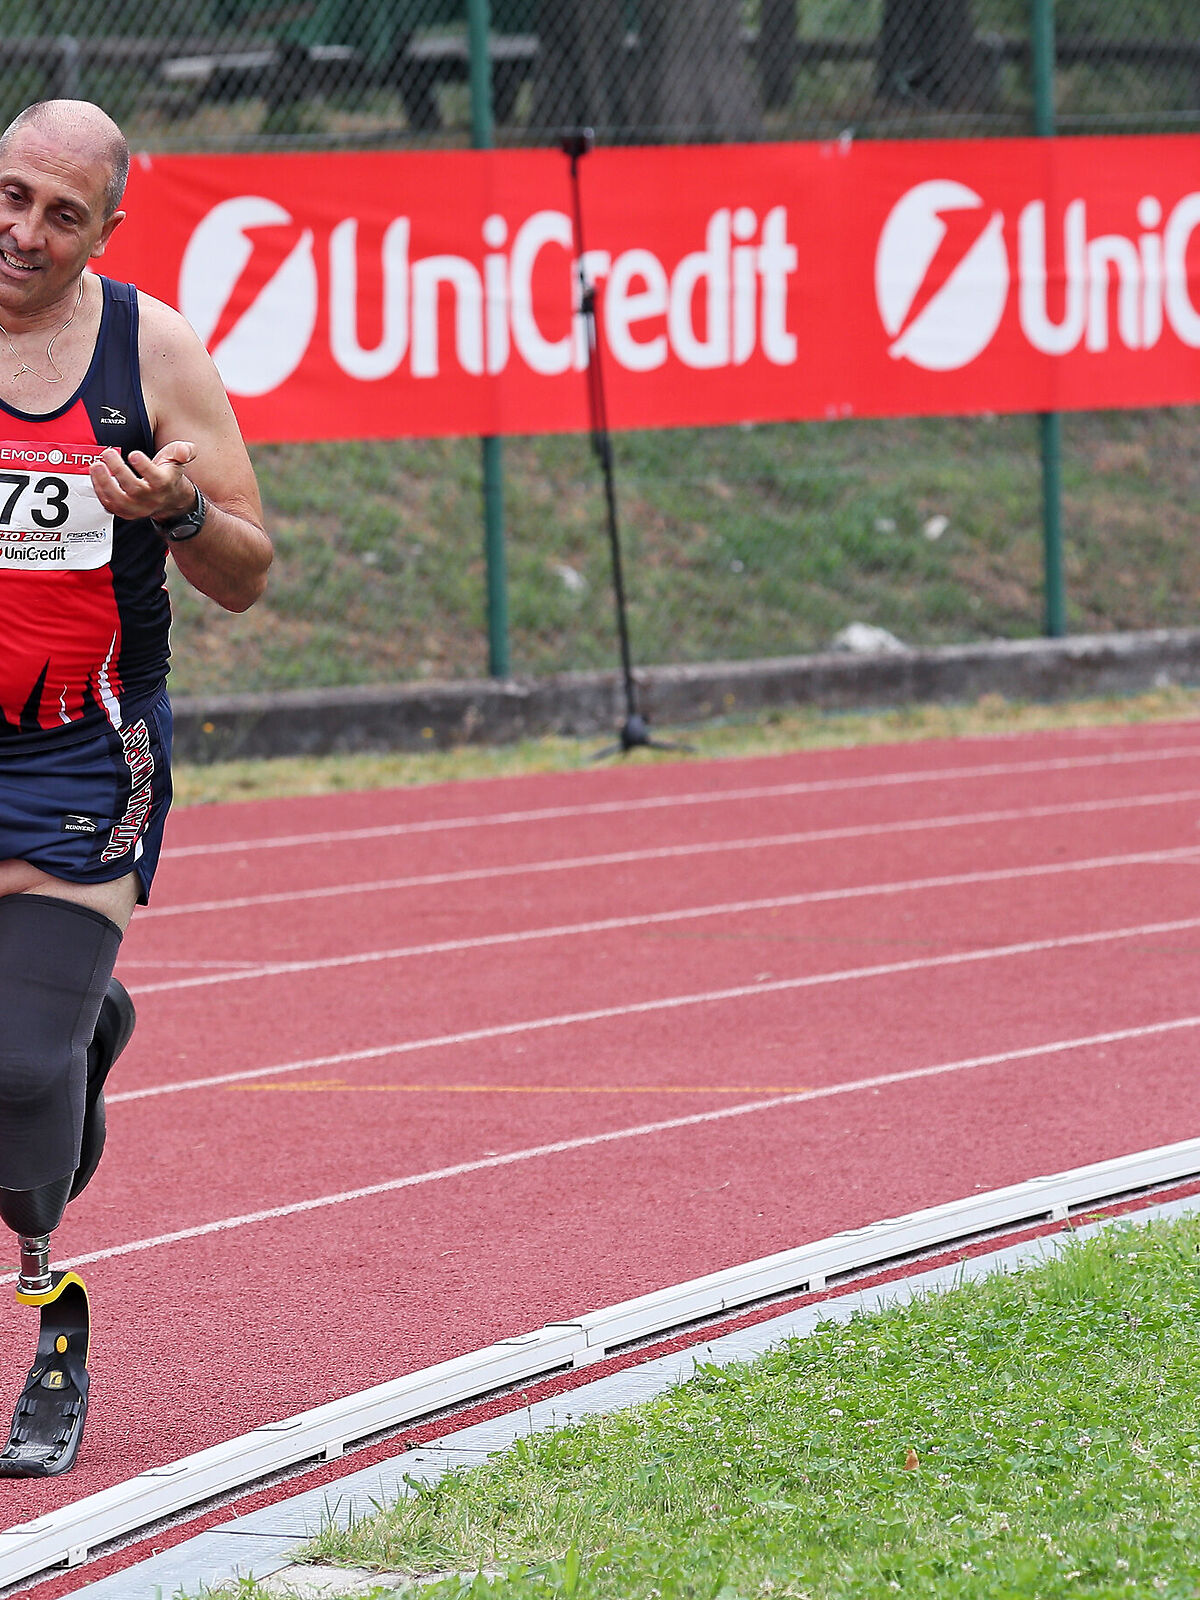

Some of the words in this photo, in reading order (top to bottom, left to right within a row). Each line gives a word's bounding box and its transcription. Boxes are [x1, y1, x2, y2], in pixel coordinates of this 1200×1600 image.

[1017, 191, 1200, 356] UniC
[329, 206, 798, 381] UniCredit
[100, 417, 126, 425] RUNNERS
[22, 532, 59, 541] 2021
[5, 546, 66, 561] UniCredit
[65, 824, 95, 832] RUNNERS
[101, 780, 151, 862] CIVITANVA
